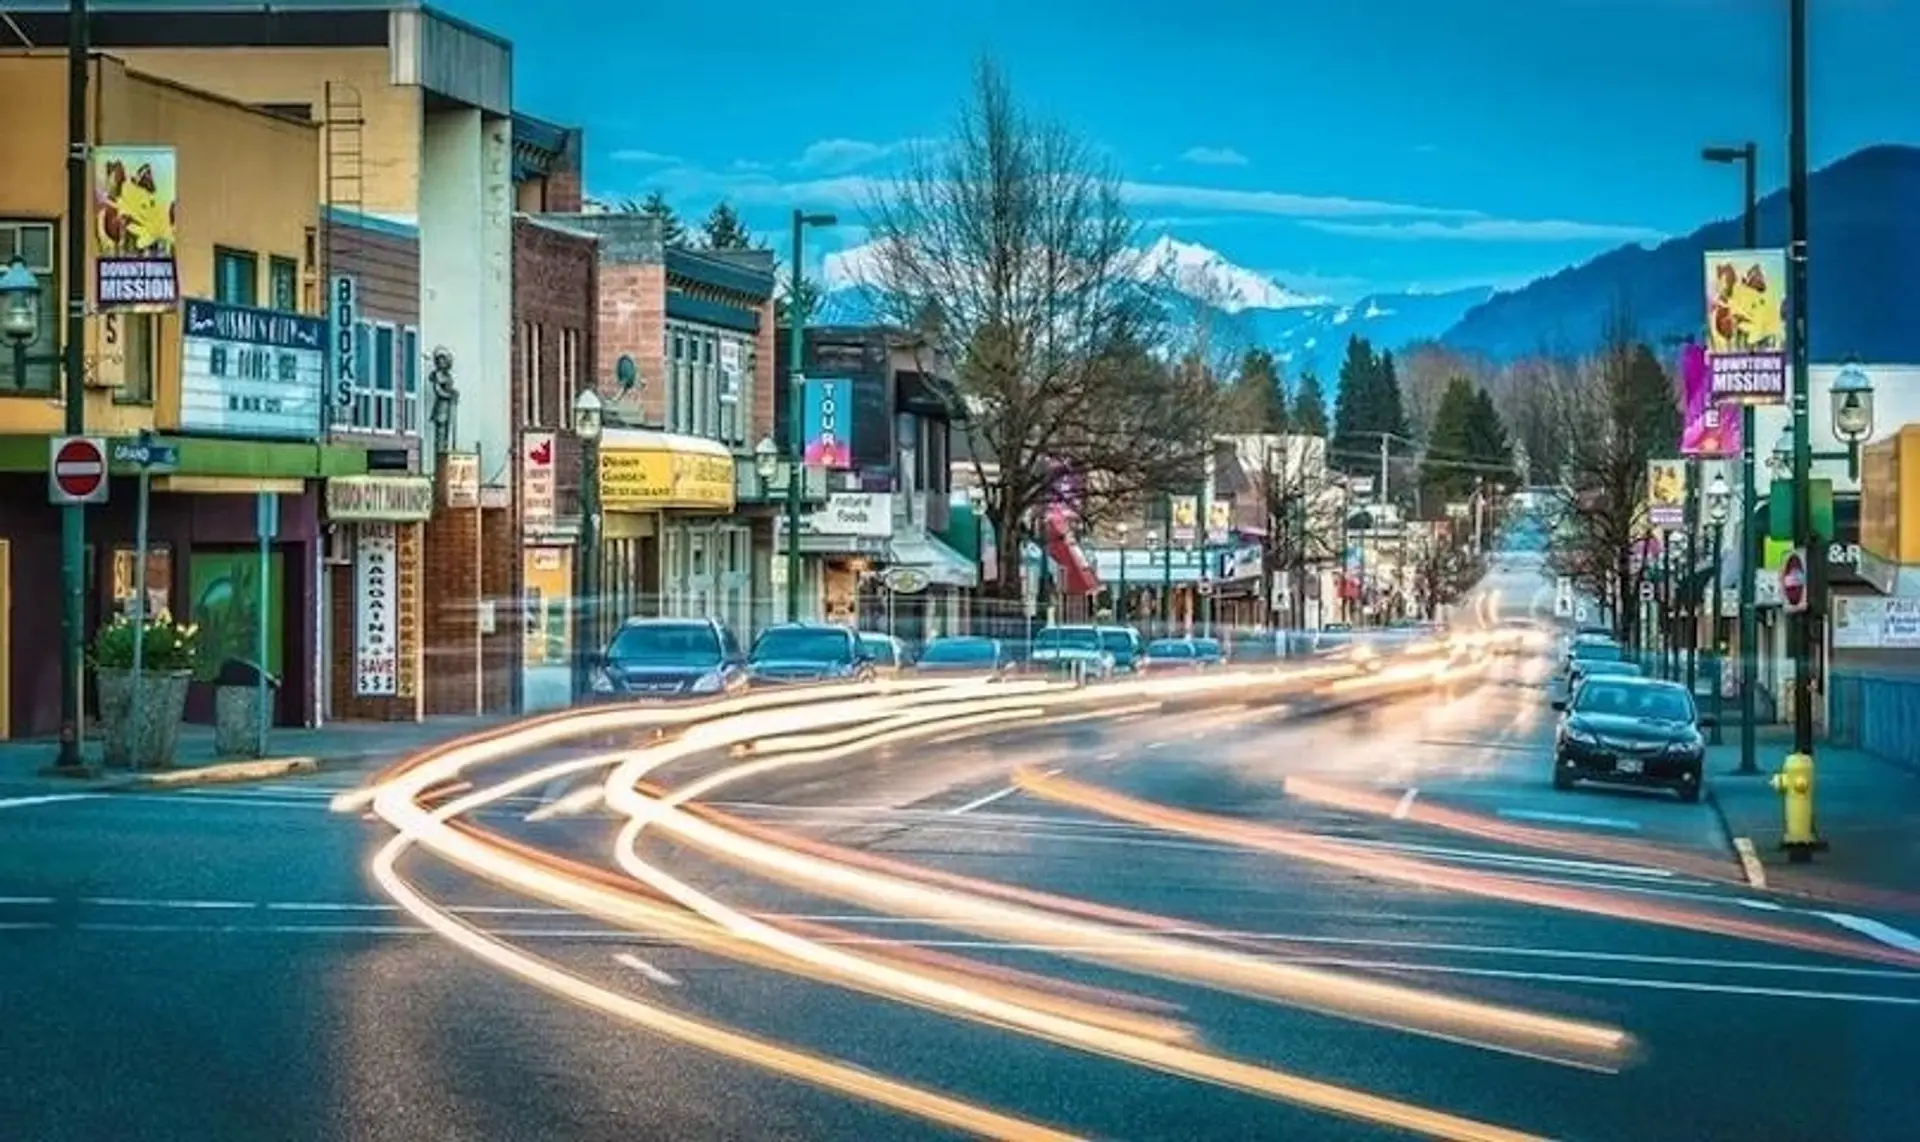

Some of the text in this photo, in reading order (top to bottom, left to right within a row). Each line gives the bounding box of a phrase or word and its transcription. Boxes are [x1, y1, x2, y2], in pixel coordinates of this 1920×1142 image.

[100, 261, 173, 277] DOWNTOWN
[100, 279, 175, 299] MISSION
[338, 278, 353, 406] BOOKS
[1712, 356, 1782, 372] DOWNTOWN
[1712, 372, 1783, 392] MISSION
[822, 383, 835, 446] TOUR
[837, 508, 868, 523] foods
[368, 553, 385, 644] BARGAINS
[361, 659, 394, 674] SAVE
